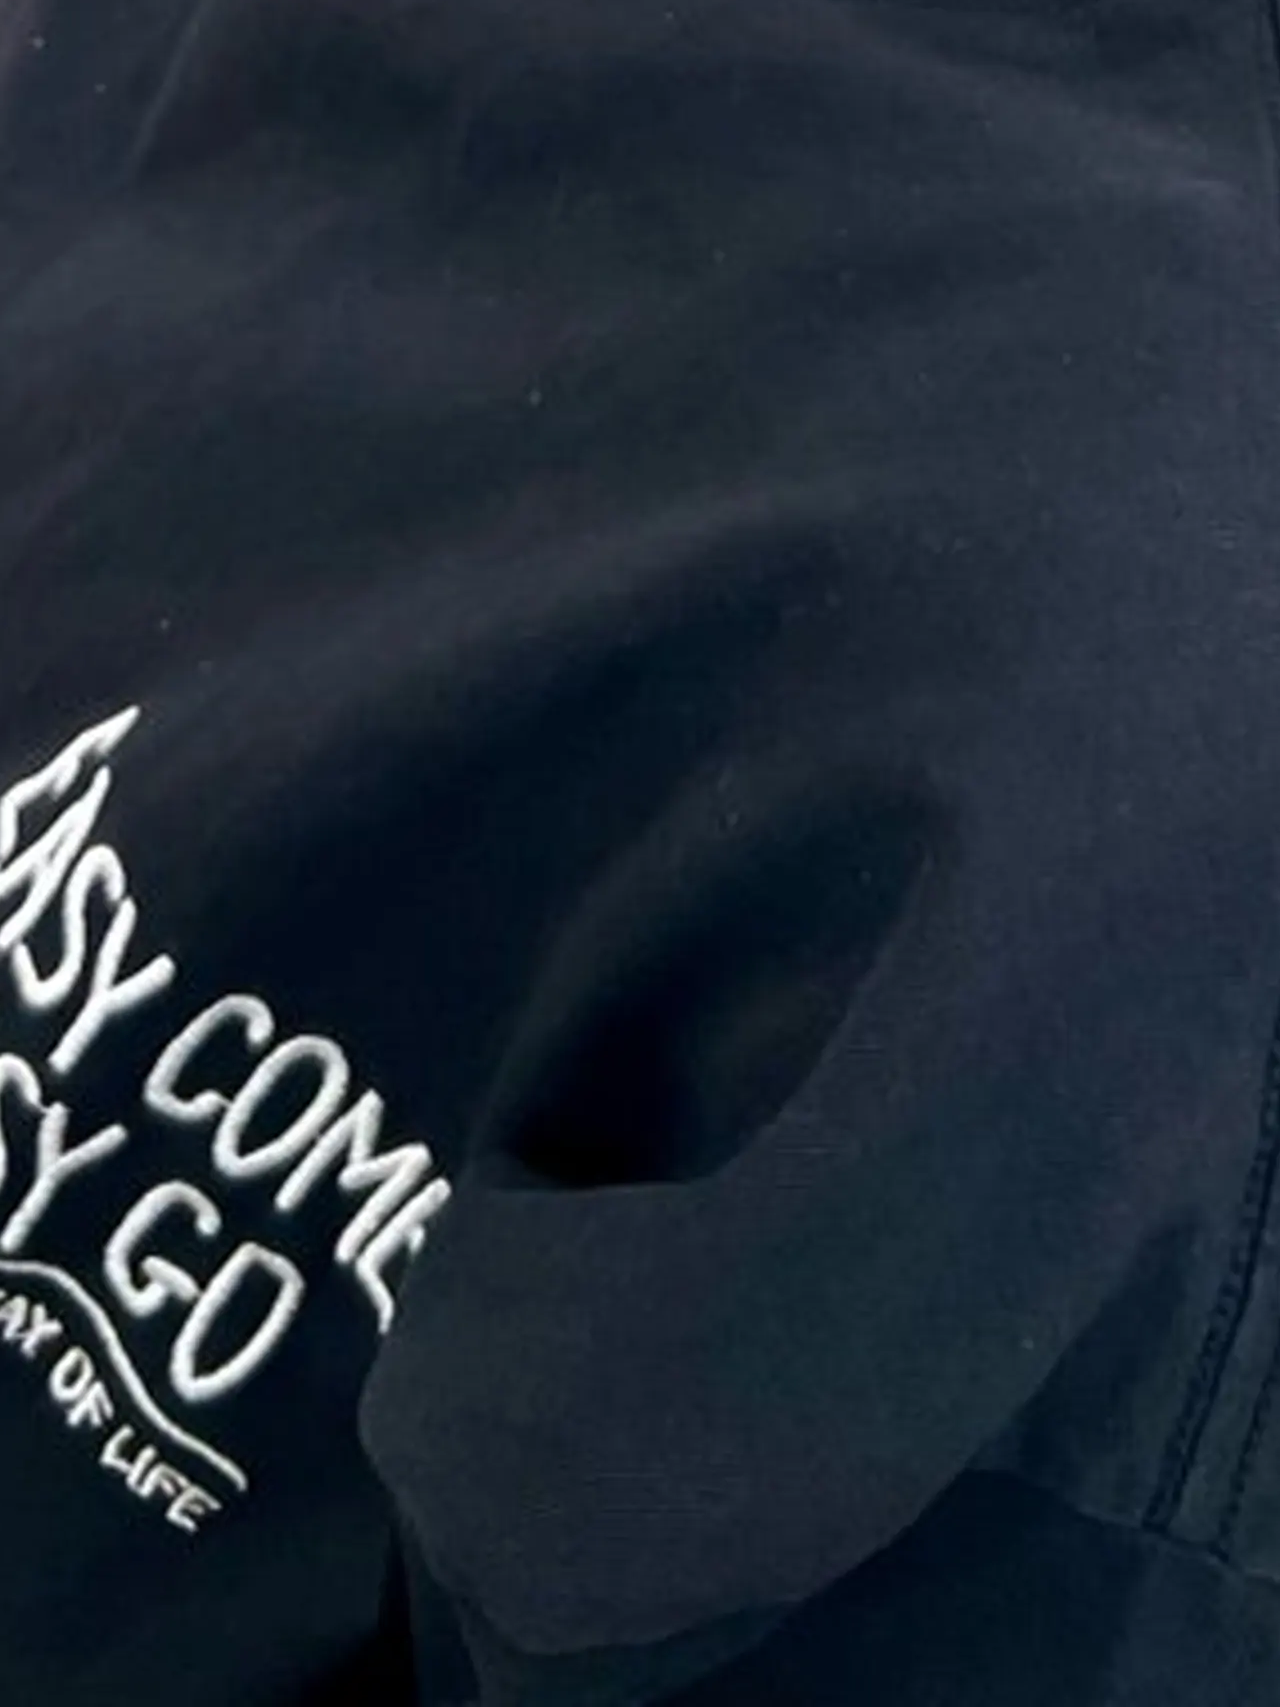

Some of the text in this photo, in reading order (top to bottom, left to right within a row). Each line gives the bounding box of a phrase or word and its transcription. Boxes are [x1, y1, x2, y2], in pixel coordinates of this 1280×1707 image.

[142, 991, 452, 1335] COME
[103, 1179, 306, 1403] GO
[49, 1344, 115, 1428] OF
[99, 1424, 223, 1534] LIFE
